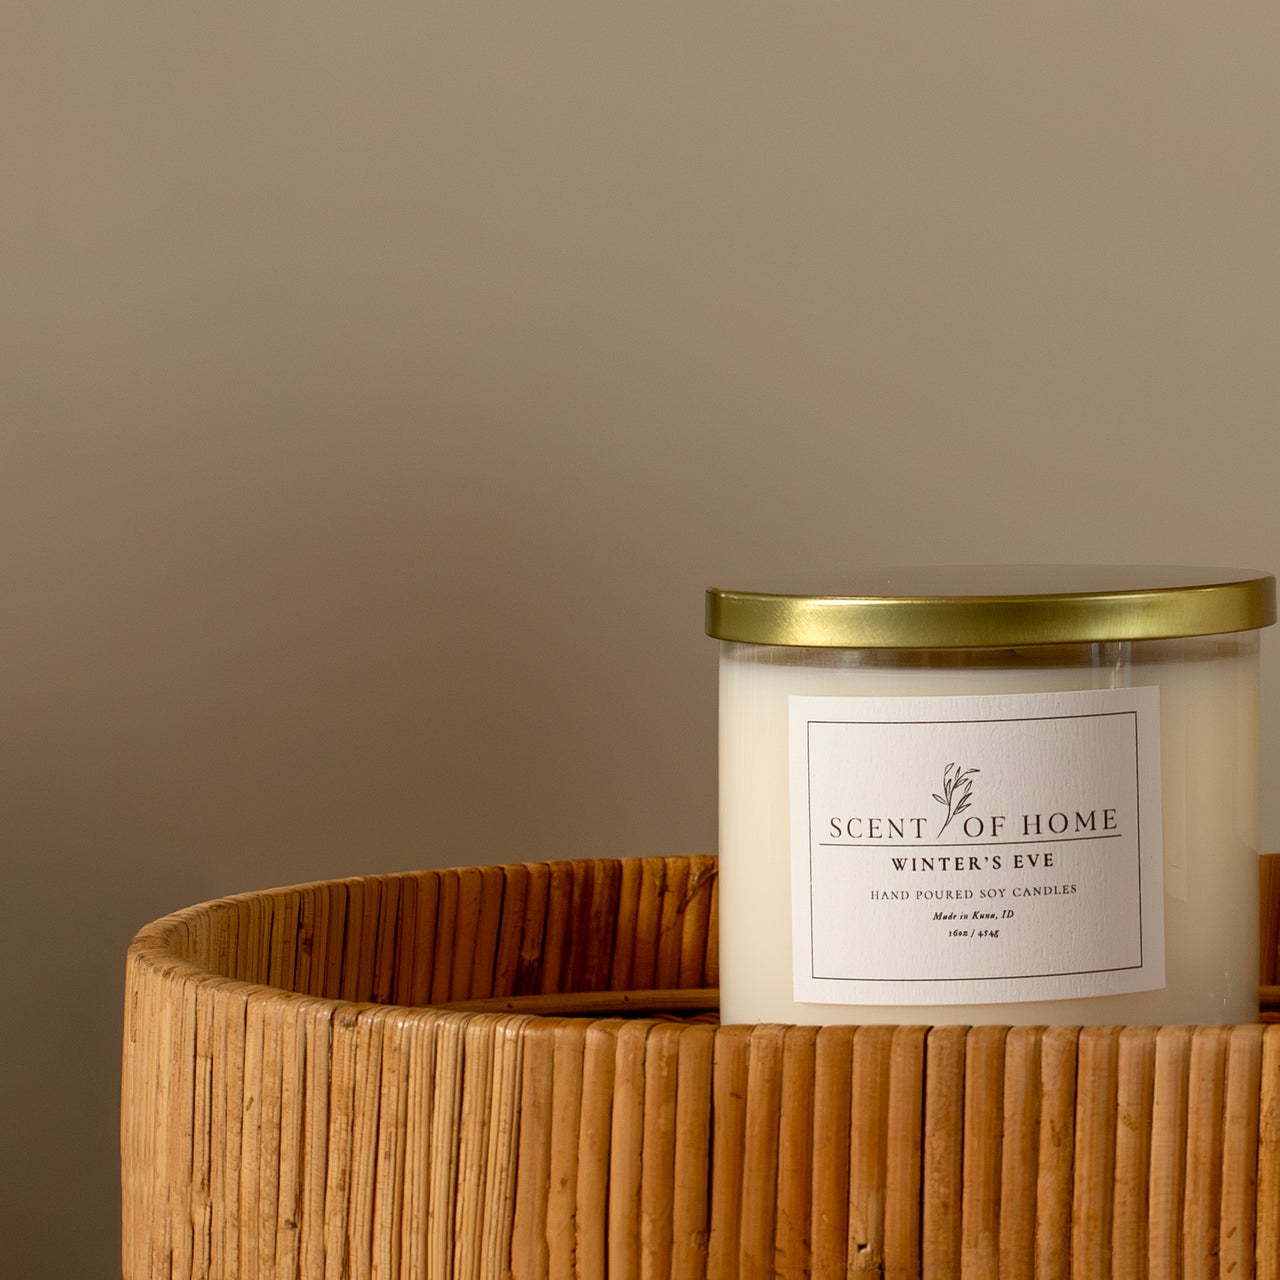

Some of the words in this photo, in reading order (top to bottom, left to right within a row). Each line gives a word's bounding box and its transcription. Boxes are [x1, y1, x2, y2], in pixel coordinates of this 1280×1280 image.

[830, 817, 928, 839] SCENT
[963, 816, 1006, 838] OF
[1023, 809, 1118, 835] HOME
[891, 855, 1002, 872] WINTER'S
[1014, 852, 1054, 869] EVE
[871, 890, 910, 900] HAND
[916, 889, 974, 900] POURED
[979, 888, 1006, 899] SOY
[1012, 883, 1077, 897] CANDLES
[932, 911, 957, 921] Made
[959, 911, 969, 921] in
[971, 910, 998, 920] Kuna,
[1001, 909, 1015, 919] ID
